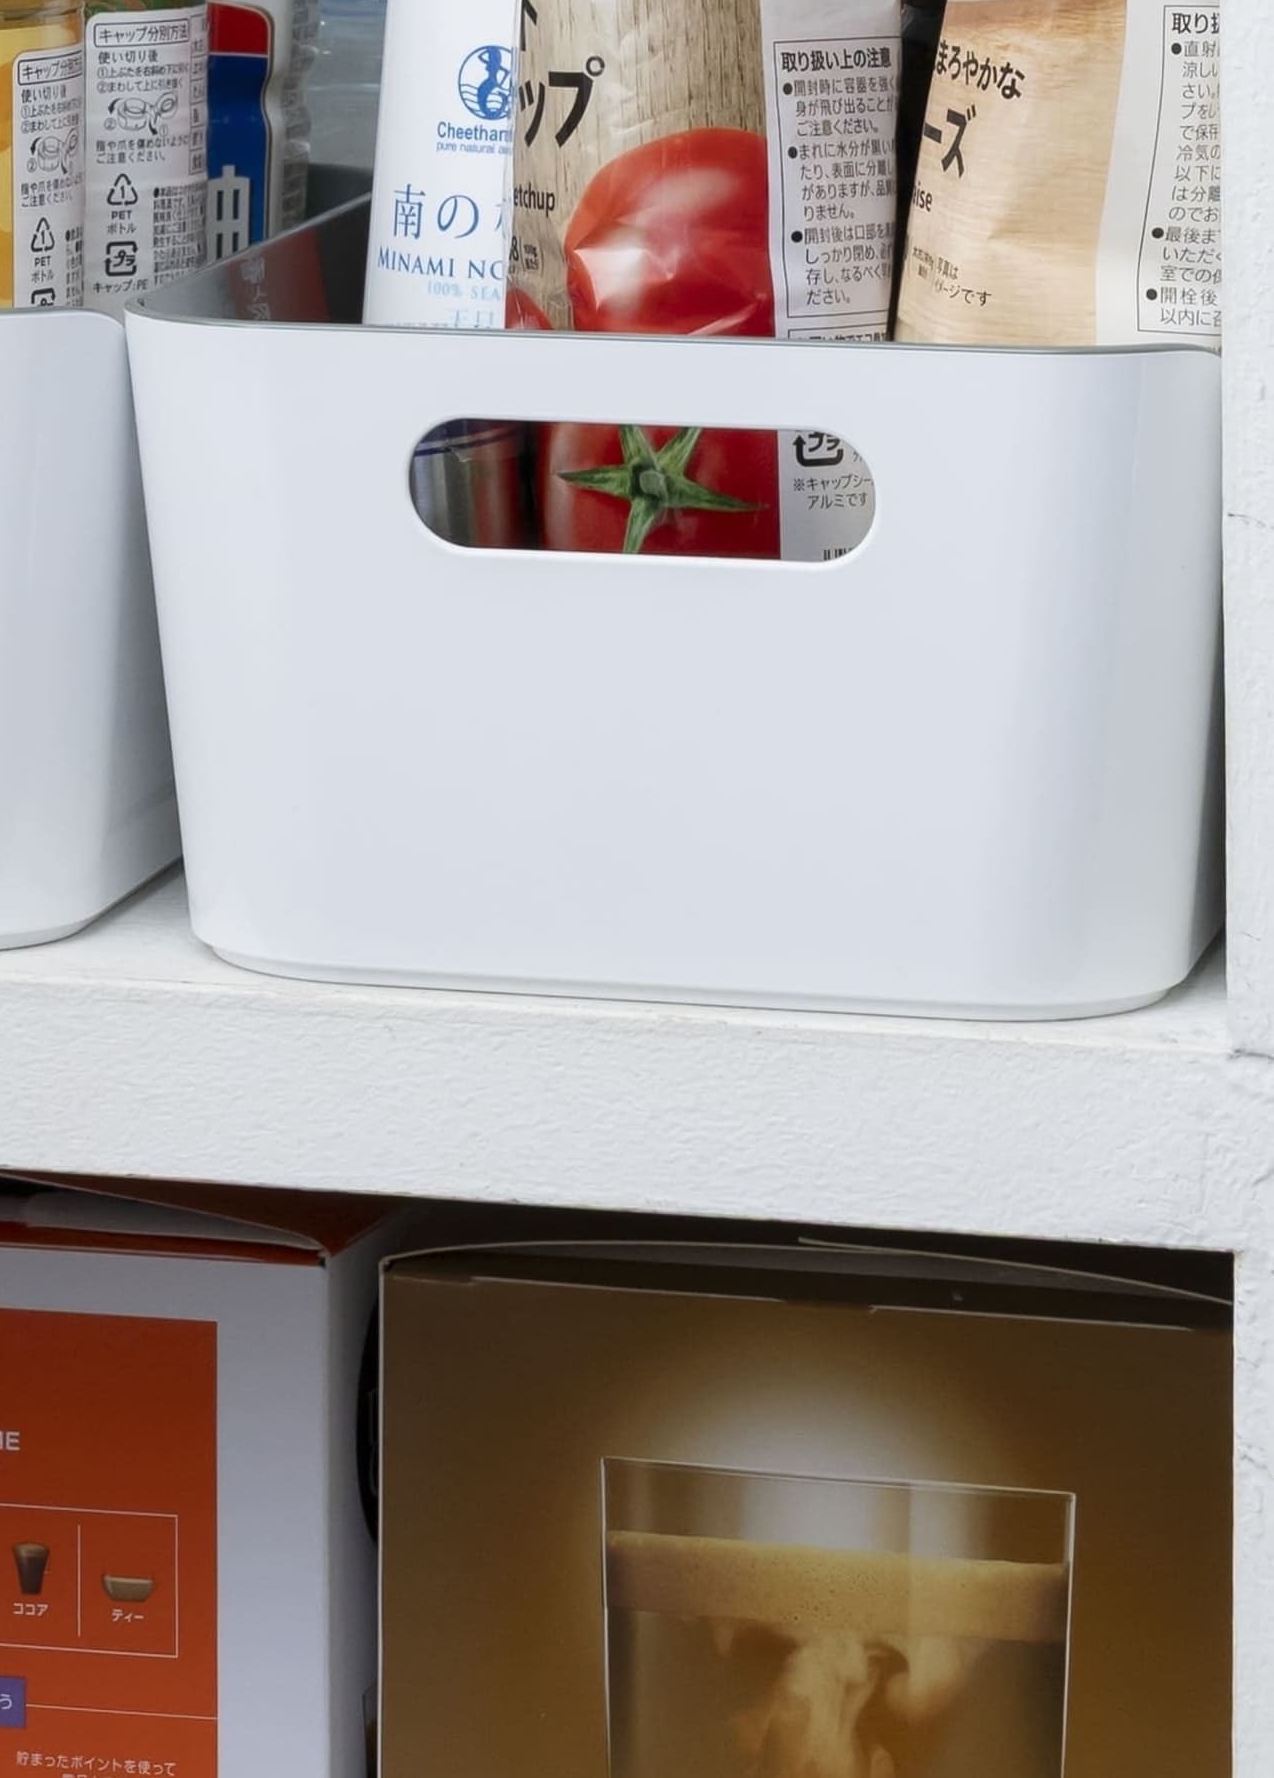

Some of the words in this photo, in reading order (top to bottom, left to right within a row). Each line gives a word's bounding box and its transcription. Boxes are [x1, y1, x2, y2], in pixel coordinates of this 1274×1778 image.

[97, 23, 187, 44] キャップ分別方法
[97, 50, 158, 65] 使い切り後
[780, 46, 892, 73] 取り扱い上の注意
[935, 38, 1026, 100] まろやかな
[797, 117, 880, 137] ご注意ください。
[110, 209, 132, 220] PET
[803, 203, 856, 222] りません。
[106, 223, 137, 235] ボトル
[34, 254, 52, 267] PET
[377, 245, 455, 279] MINAMI
[806, 288, 851, 306] ださい。
[806, 491, 869, 511] アルミです
[12, 1601, 50, 1618] ココア
[110, 1607, 145, 1624] ティー
[15, 1748, 178, 1778] 貯まったポイントを使って
